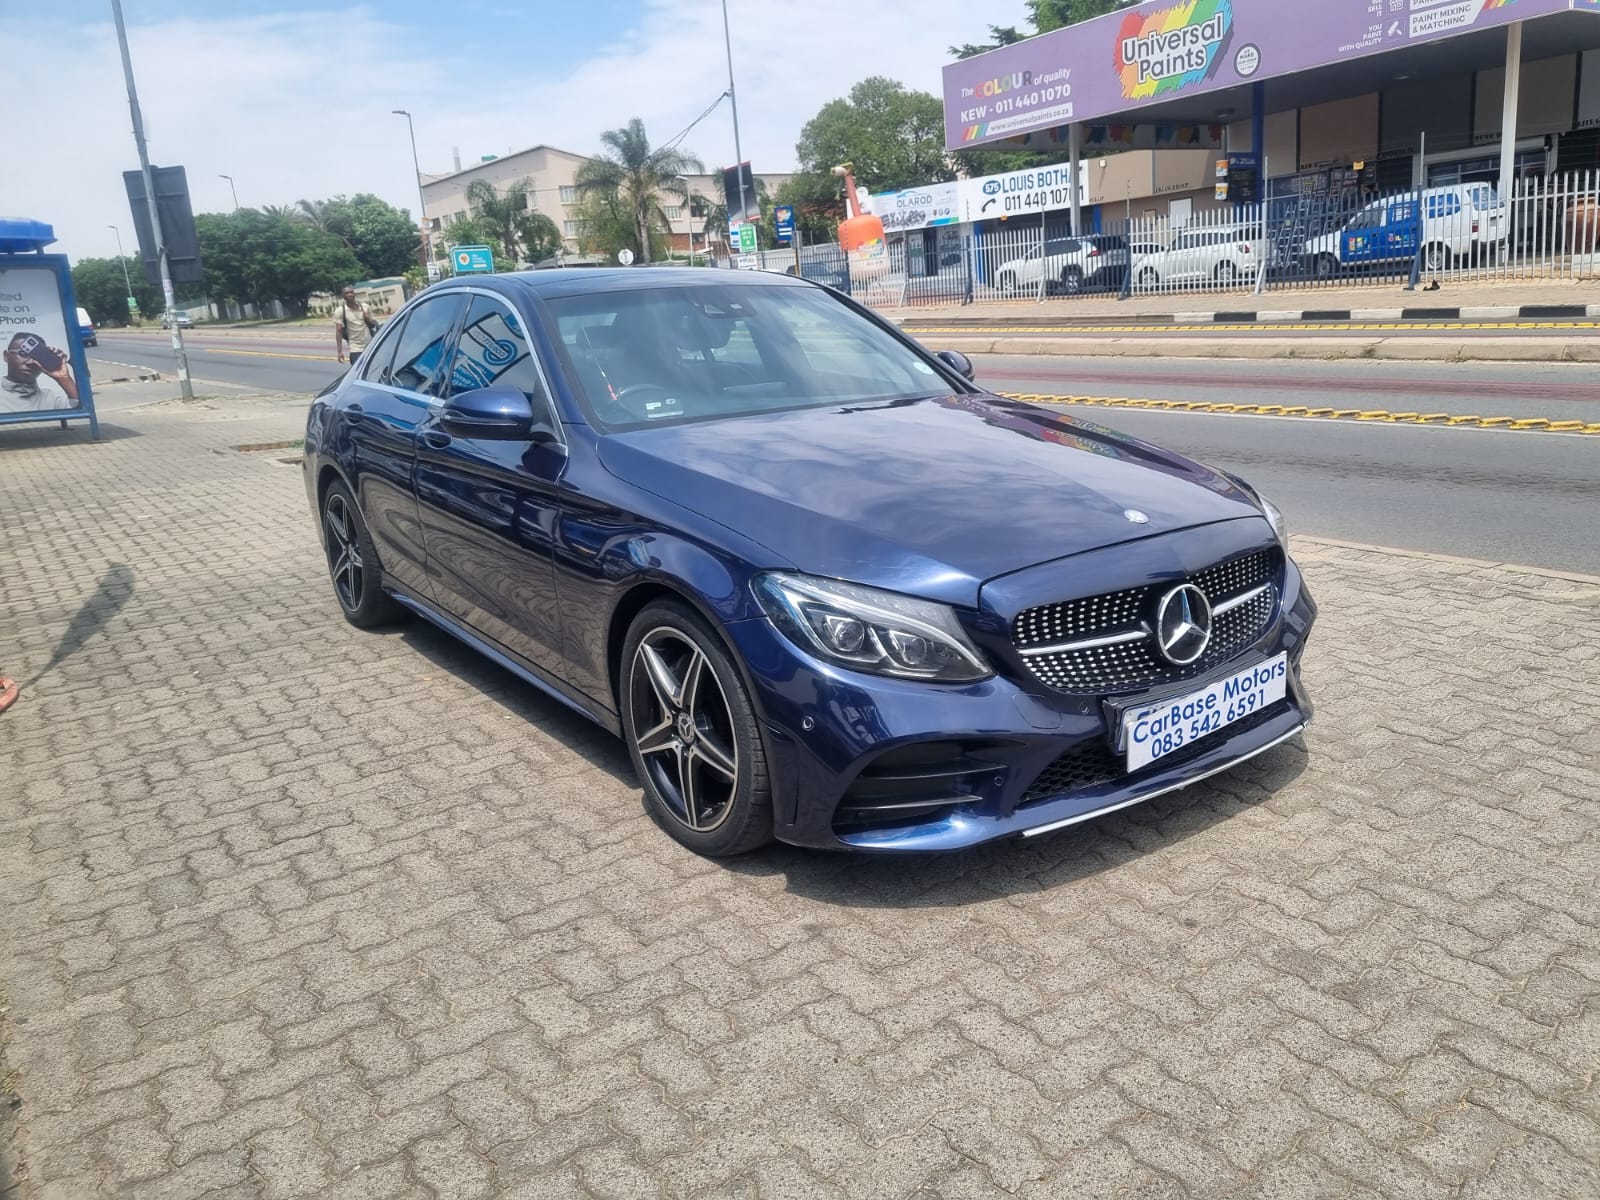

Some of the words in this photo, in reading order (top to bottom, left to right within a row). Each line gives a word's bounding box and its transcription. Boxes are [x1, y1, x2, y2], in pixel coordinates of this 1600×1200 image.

[1412, 12, 1438, 25] PAINT
[1439, 4, 1471, 18] MIXING
[1412, 26, 1418, 34] &
[1419, 15, 1466, 32] MATCHING
[1123, 13, 1222, 63] Universal
[1363, 30, 1383, 41] PAINT
[1368, 23, 1383, 32] YOU
[1355, 37, 1383, 49] QUALITY
[1139, 48, 1206, 82] Paints
[961, 87, 974, 99] The
[975, 70, 1033, 99] COLOUR
[1033, 73, 1043, 86] of
[1043, 67, 1072, 85] quality
[960, 105, 987, 123] KEW
[995, 98, 1013, 114] 011
[1015, 92, 1039, 108] 440
[1041, 83, 1071, 102] 1070
[984, 182, 999, 193] 575
[1002, 173, 1034, 194] LOUIS
[1037, 167, 1072, 188] BOTH
[1005, 194, 1021, 212] 011
[1025, 190, 1047, 207] 440
[14, 304, 30, 313] on
[1133, 691, 1217, 744] CarBase
[1222, 660, 1286, 702] Motors
[1150, 728, 1184, 759] 083
[1189, 710, 1221, 740] 542
[1226, 689, 1266, 722] 6591
